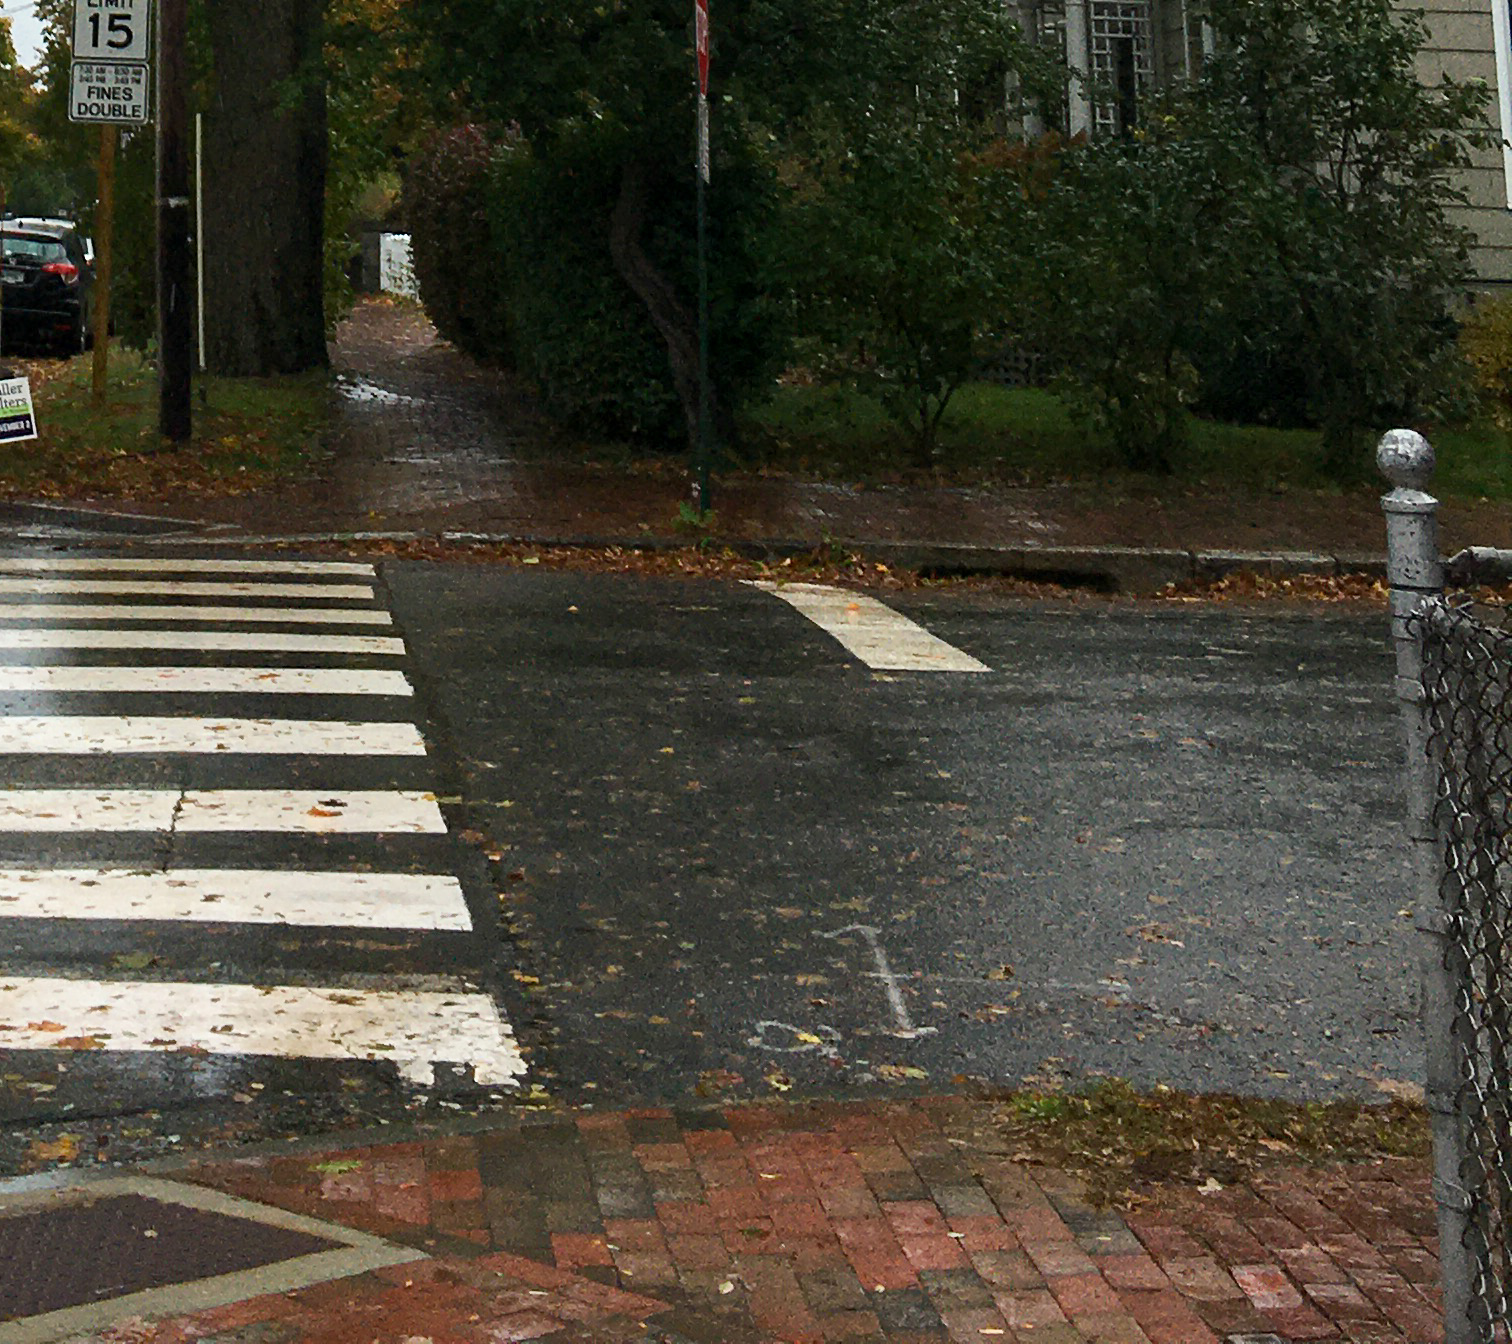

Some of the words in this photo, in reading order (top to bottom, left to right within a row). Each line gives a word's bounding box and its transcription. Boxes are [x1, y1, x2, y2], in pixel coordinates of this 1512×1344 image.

[88, 12, 133, 49] 15
[87, 86, 133, 101] FINES
[77, 103, 142, 118] DOUBLE
